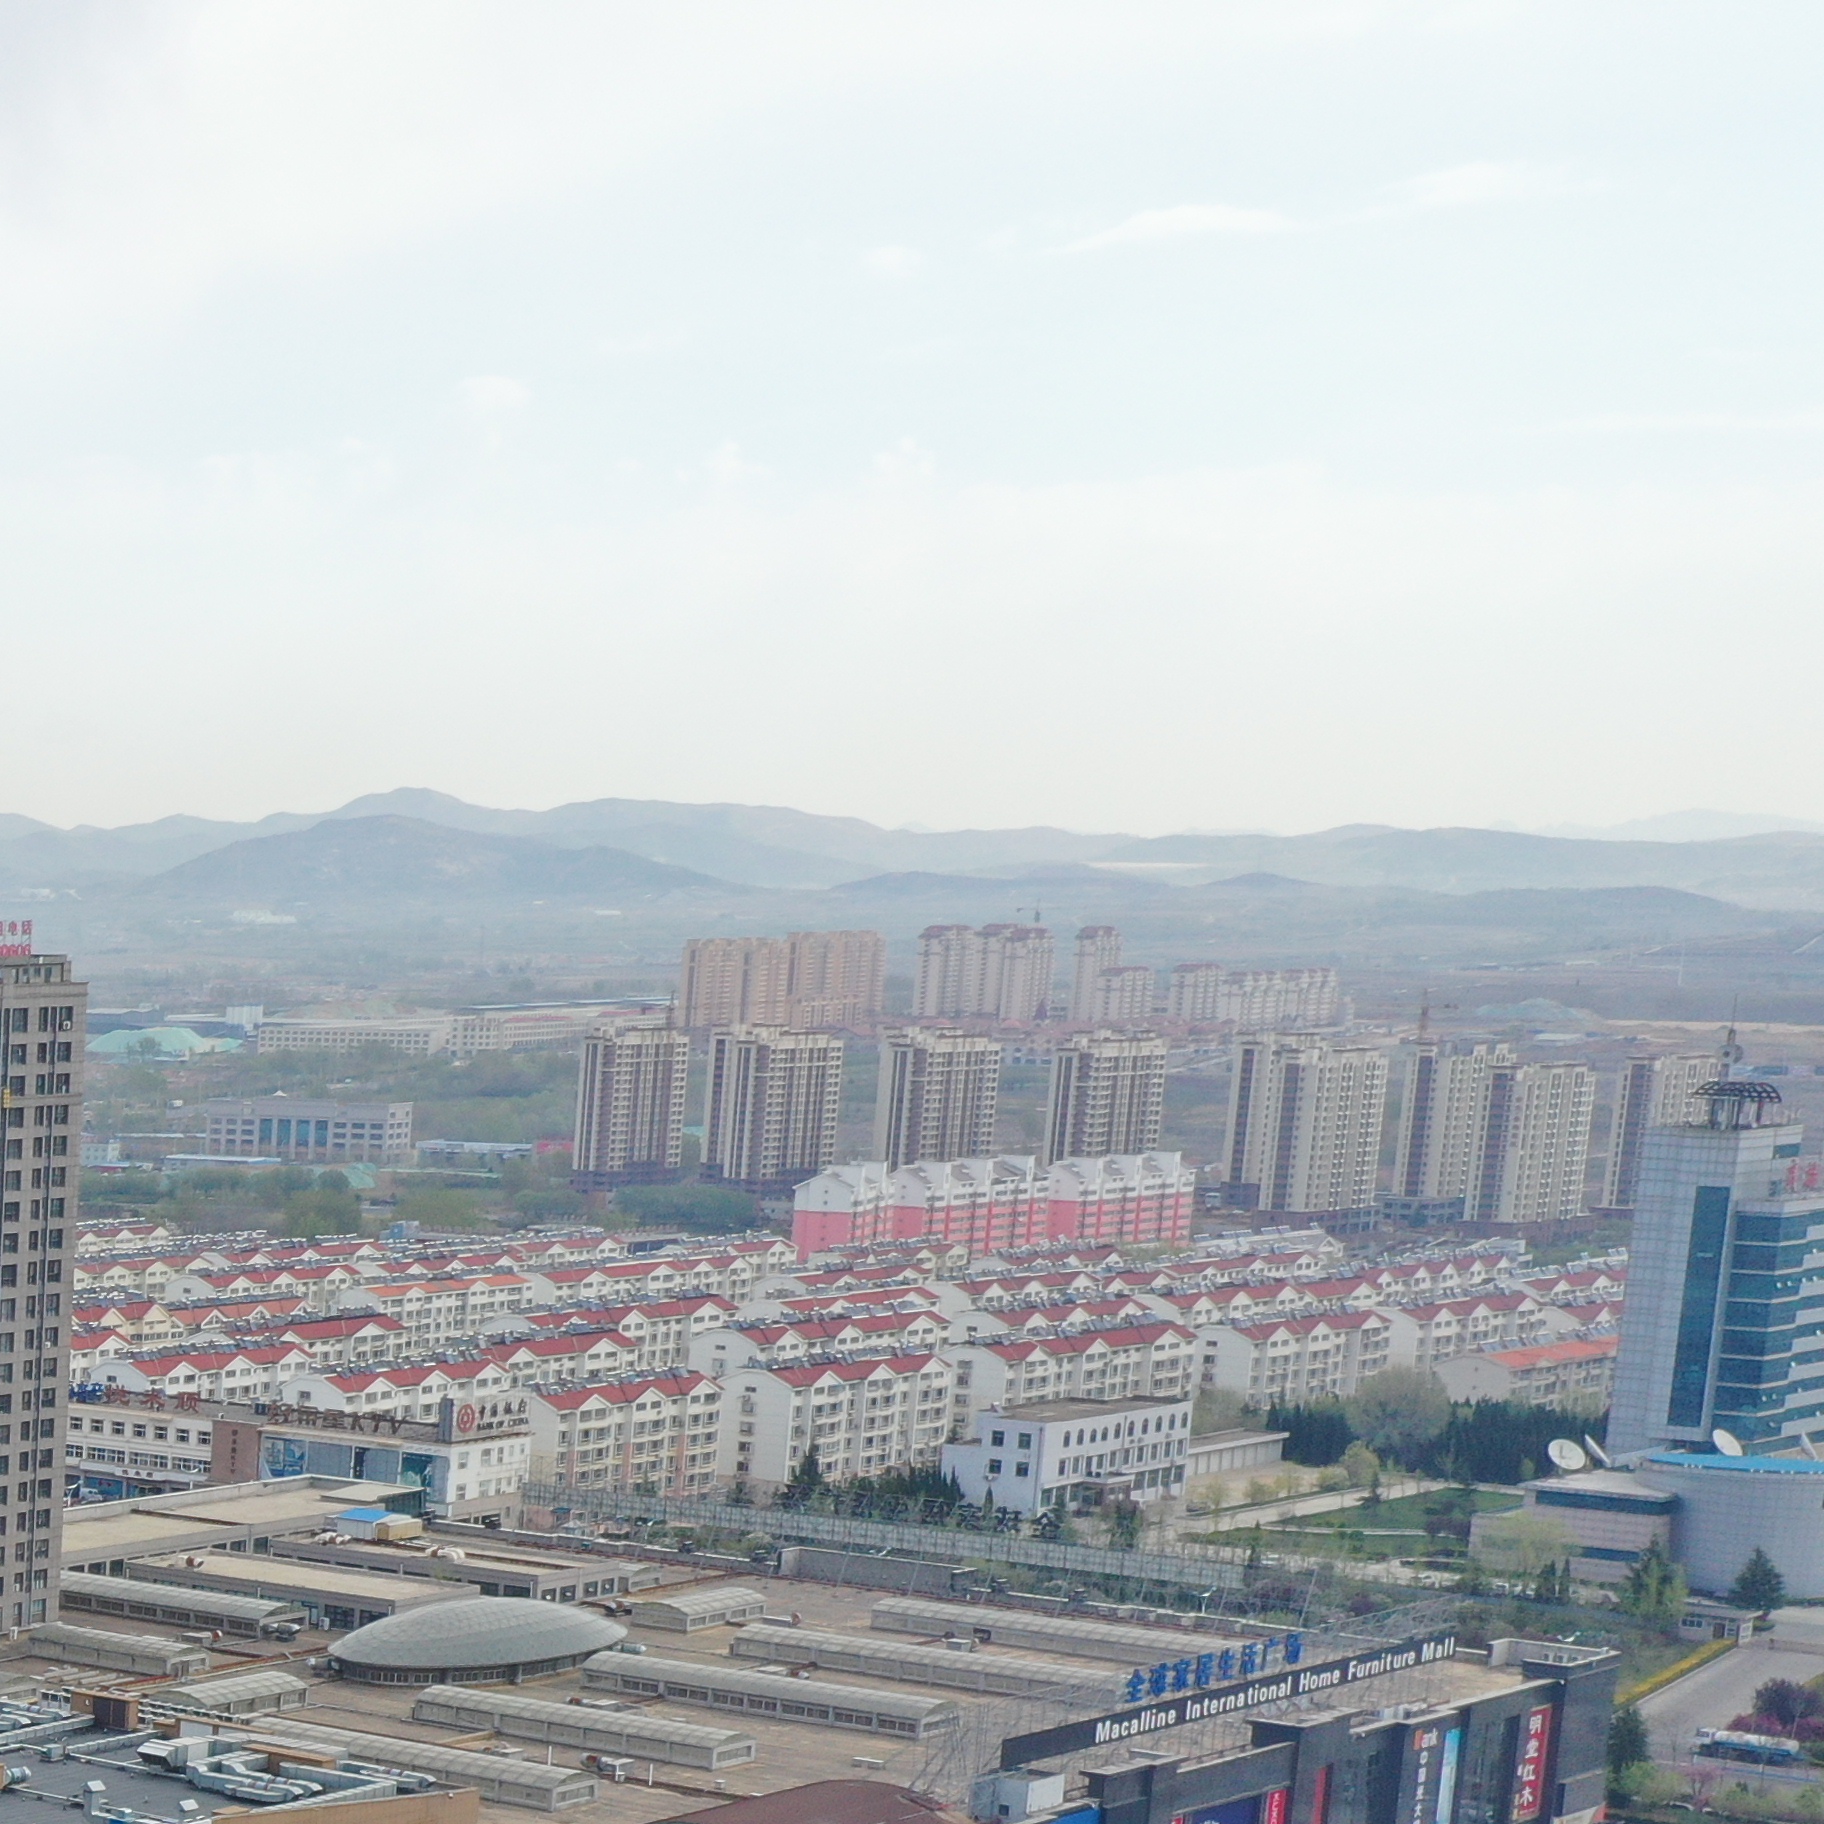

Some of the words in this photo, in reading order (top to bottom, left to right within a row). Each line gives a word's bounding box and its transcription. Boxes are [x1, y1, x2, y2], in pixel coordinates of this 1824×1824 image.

[1095, 1708, 1176, 1743] Macalline
[1186, 1676, 1292, 1720] International
[1299, 1669, 1340, 1693] Home
[1348, 1651, 1416, 1681] Furniture
[1421, 1637, 1455, 1663] Mall
[1125, 1632, 1305, 1703] 全球家居生活广场
